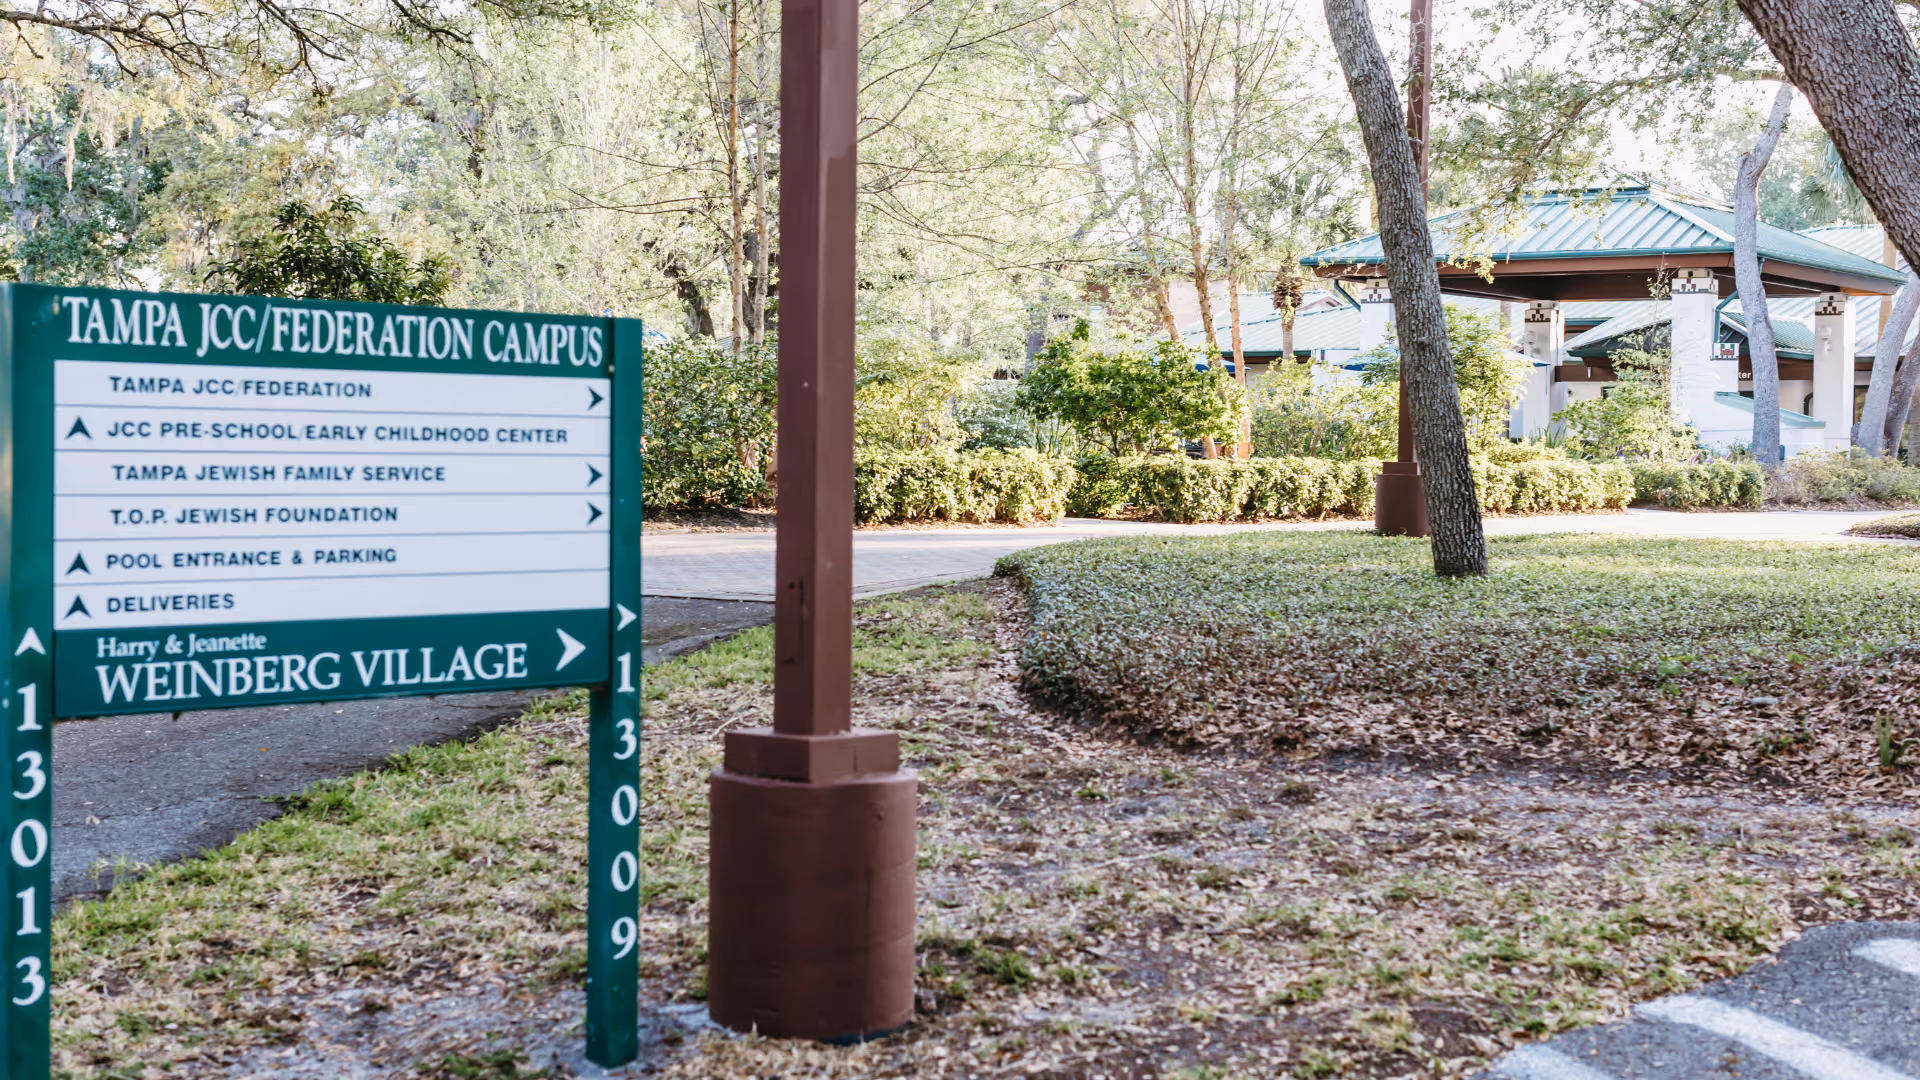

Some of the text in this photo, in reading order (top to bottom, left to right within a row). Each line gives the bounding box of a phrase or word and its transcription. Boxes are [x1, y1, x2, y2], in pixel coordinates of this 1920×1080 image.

[62, 296, 602, 367] TAMPA JCC/FEDERATION CAMPUS
[109, 376, 185, 394] TAMPA
[107, 421, 151, 438] JCC
[375, 426, 489, 442] CHILDHOOD
[496, 428, 568, 444] CENTER
[112, 464, 445, 482] TAMPA JEWISH FAMILY SERVICE
[110, 507, 398, 525] T.O.P. JEWISH FOUNDATION
[106, 548, 397, 570] POOL ENTRANCE & PARKING
[106, 593, 235, 613] DELIVERIES
[97, 632, 267, 662] Harry & Jeanette
[95, 642, 529, 704] WEINBERG VILLAGE
[611, 652, 638, 960] 13009
[10, 682, 48, 1006] 13013
